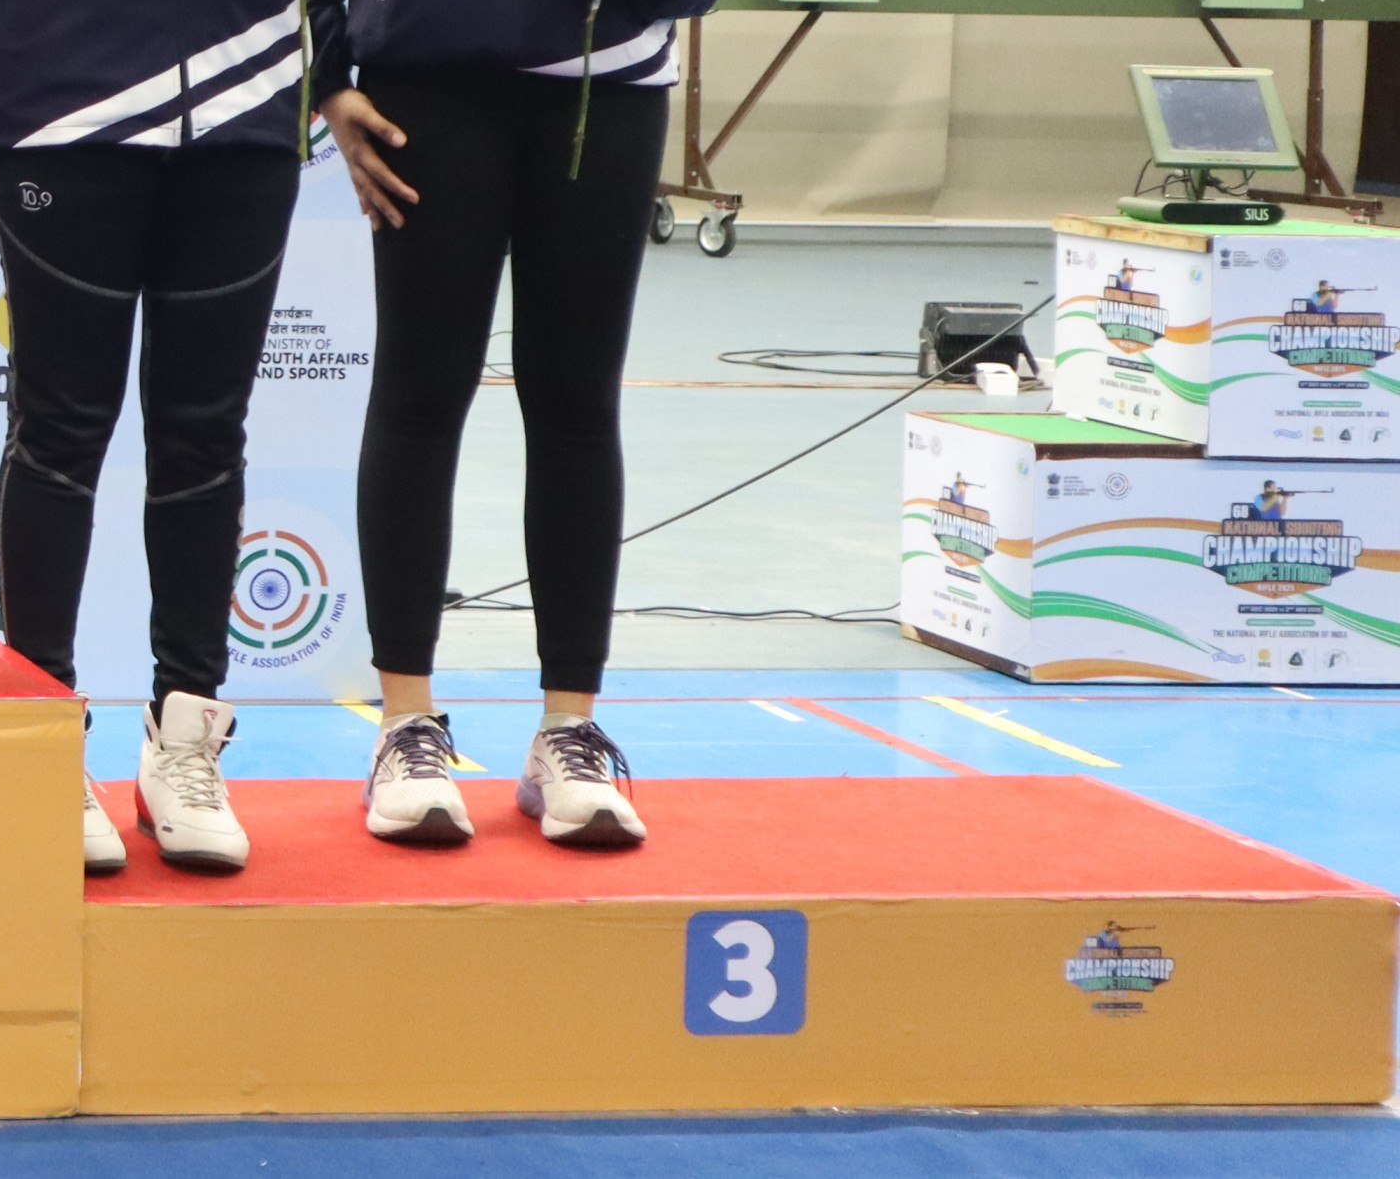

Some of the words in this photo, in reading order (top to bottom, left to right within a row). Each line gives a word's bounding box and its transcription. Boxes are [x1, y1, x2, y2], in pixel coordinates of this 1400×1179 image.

[21, 187, 52, 206] 10.9
[1244, 207, 1269, 221] SIUS
[315, 339, 332, 349] OF
[308, 353, 369, 364] AFFAIRS
[289, 368, 346, 379] SPORTS
[1203, 537, 1362, 568] CHAMPIONSHIP
[251, 640, 321, 668] ASSOCIATION
[321, 626, 333, 640] OF
[331, 592, 347, 622] INDIA
[709, 920, 777, 1022] 3
[1066, 959, 1174, 980] CHAMPIONSHIP
